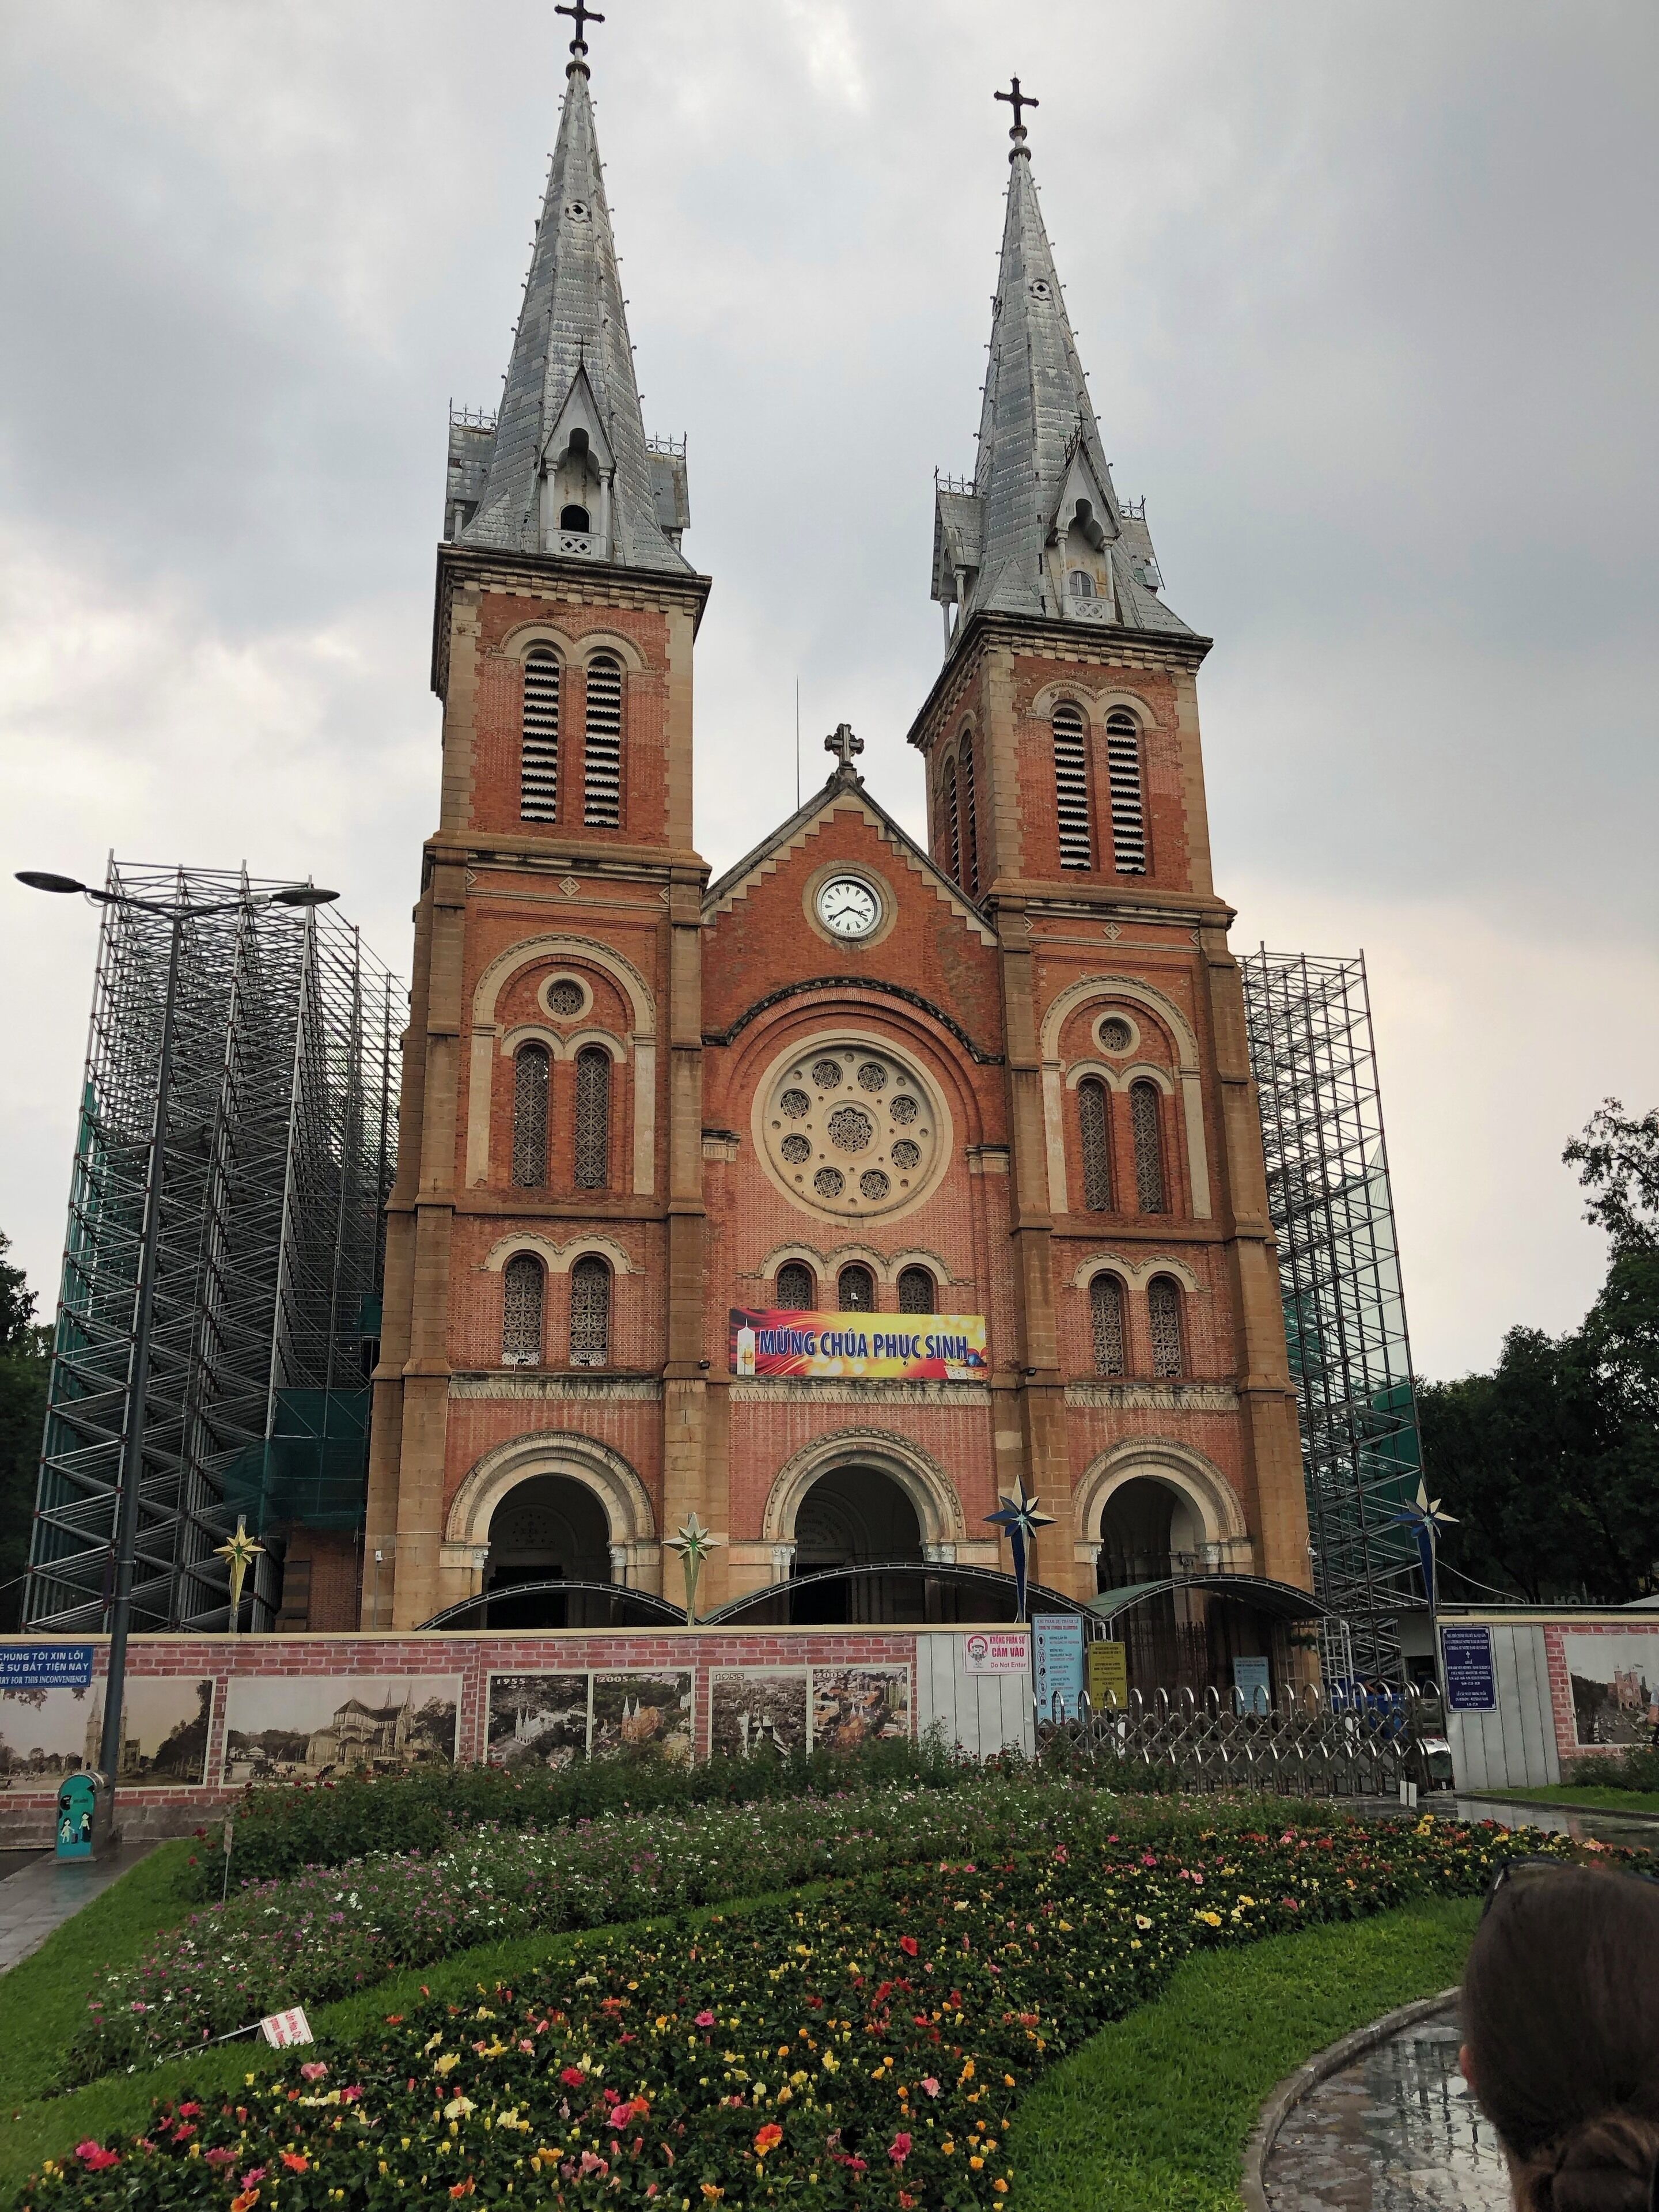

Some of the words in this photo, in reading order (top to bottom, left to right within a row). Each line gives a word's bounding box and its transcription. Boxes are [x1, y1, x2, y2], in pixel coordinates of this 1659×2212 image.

[759, 1324, 816, 1355] MỪNG
[820, 1328, 868, 1358] CHÚA
[873, 1334, 922, 1367] PHỤC
[925, 1334, 968, 1360] SINH
[32, 1652, 47, 1660] TÔI
[50, 1652, 66, 1660] XIN
[10, 1676, 23, 1684] FOR
[39, 1675, 86, 1683] INCONVENIENCE
[715, 1673, 744, 1681] 1955
